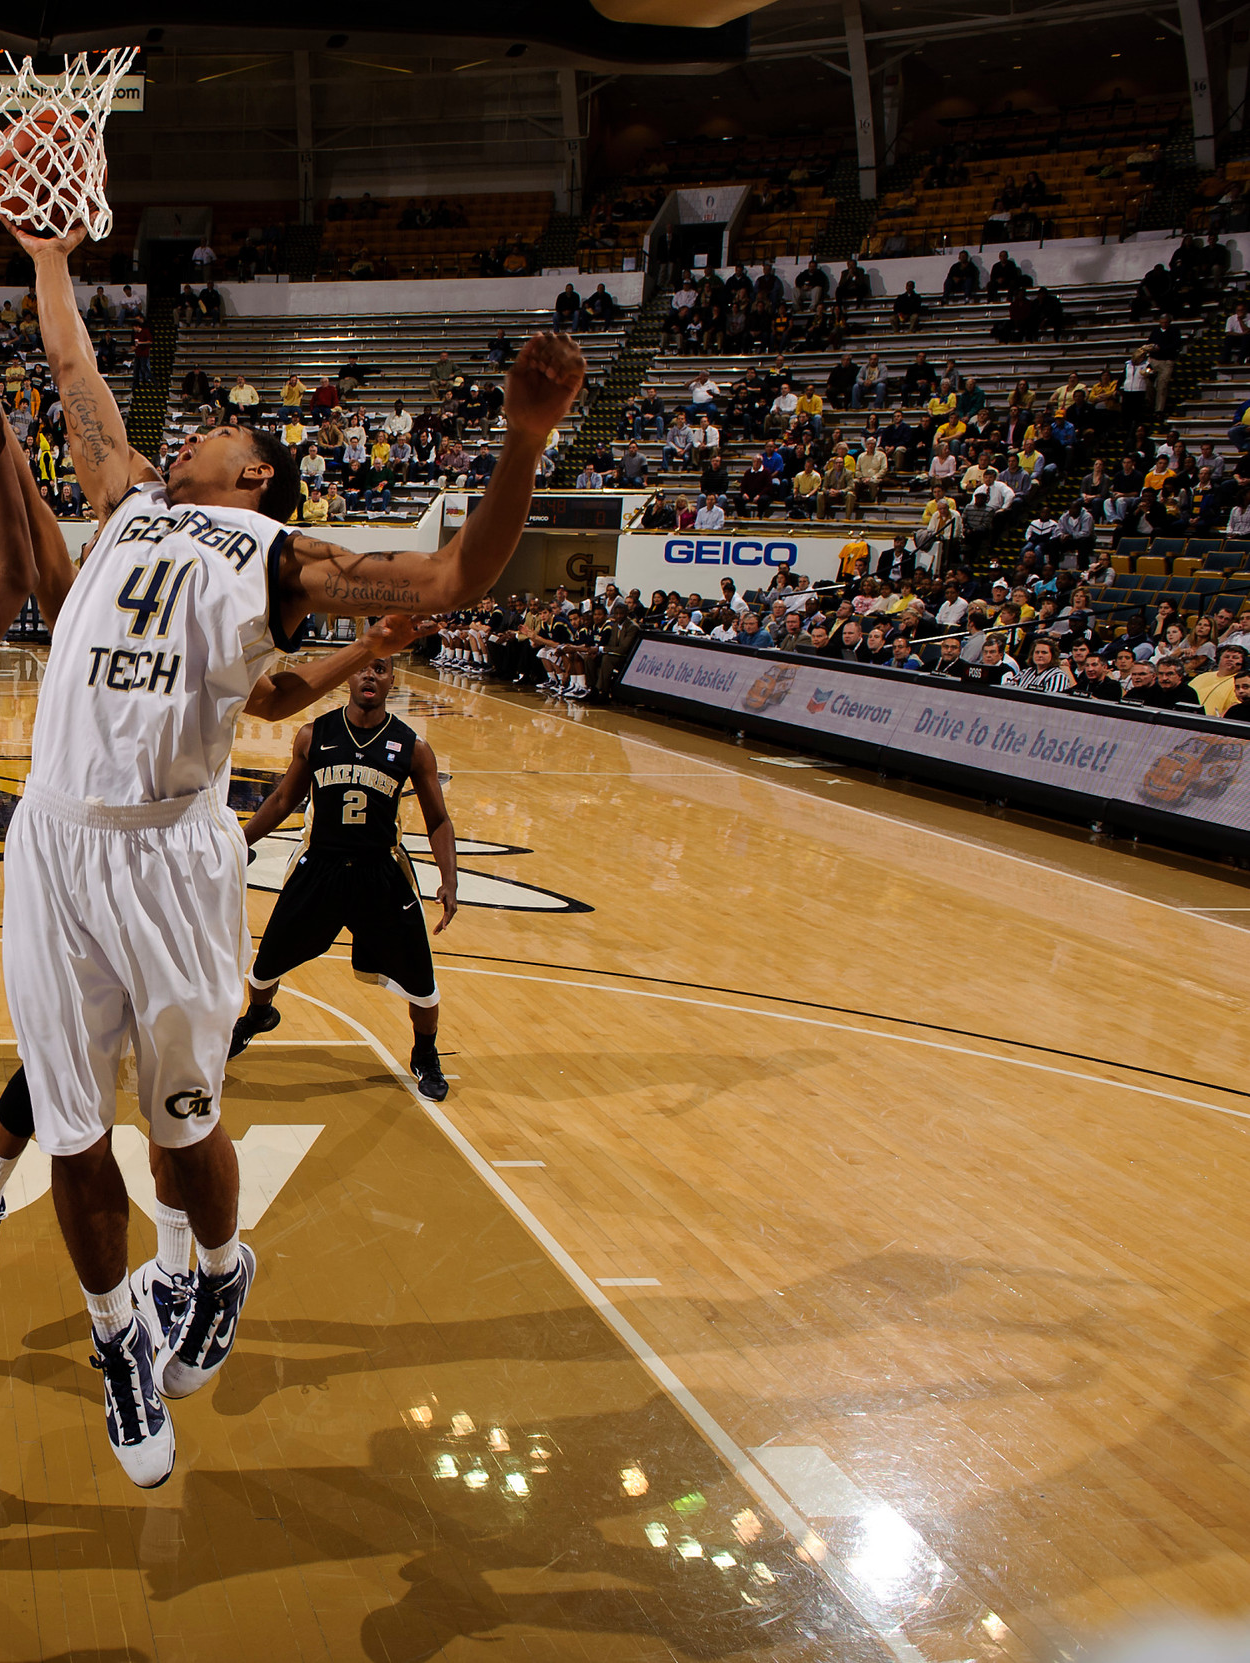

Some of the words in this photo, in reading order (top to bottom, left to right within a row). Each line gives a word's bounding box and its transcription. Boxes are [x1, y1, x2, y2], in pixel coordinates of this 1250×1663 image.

[1195, 81, 1207, 92] 16
[859, 119, 870, 129] 16
[664, 540, 798, 567] GEICO
[115, 557, 199, 640] 41
[325, 571, 421, 605] Dedication
[87, 647, 182, 696] TECH
[636, 654, 661, 677] Drive
[662, 659, 674, 680] to
[674, 661, 693, 684] the
[692, 664, 738, 692] basket!
[968, 666, 982, 679] POSS
[830, 694, 893, 725] Chevron
[914, 707, 965, 742] Drive
[966, 716, 989, 747] to
[991, 721, 1027, 755] the
[1028, 728, 1119, 773] basket!
[351, 764, 399, 798] FOREST
[342, 789, 367, 824] 2
